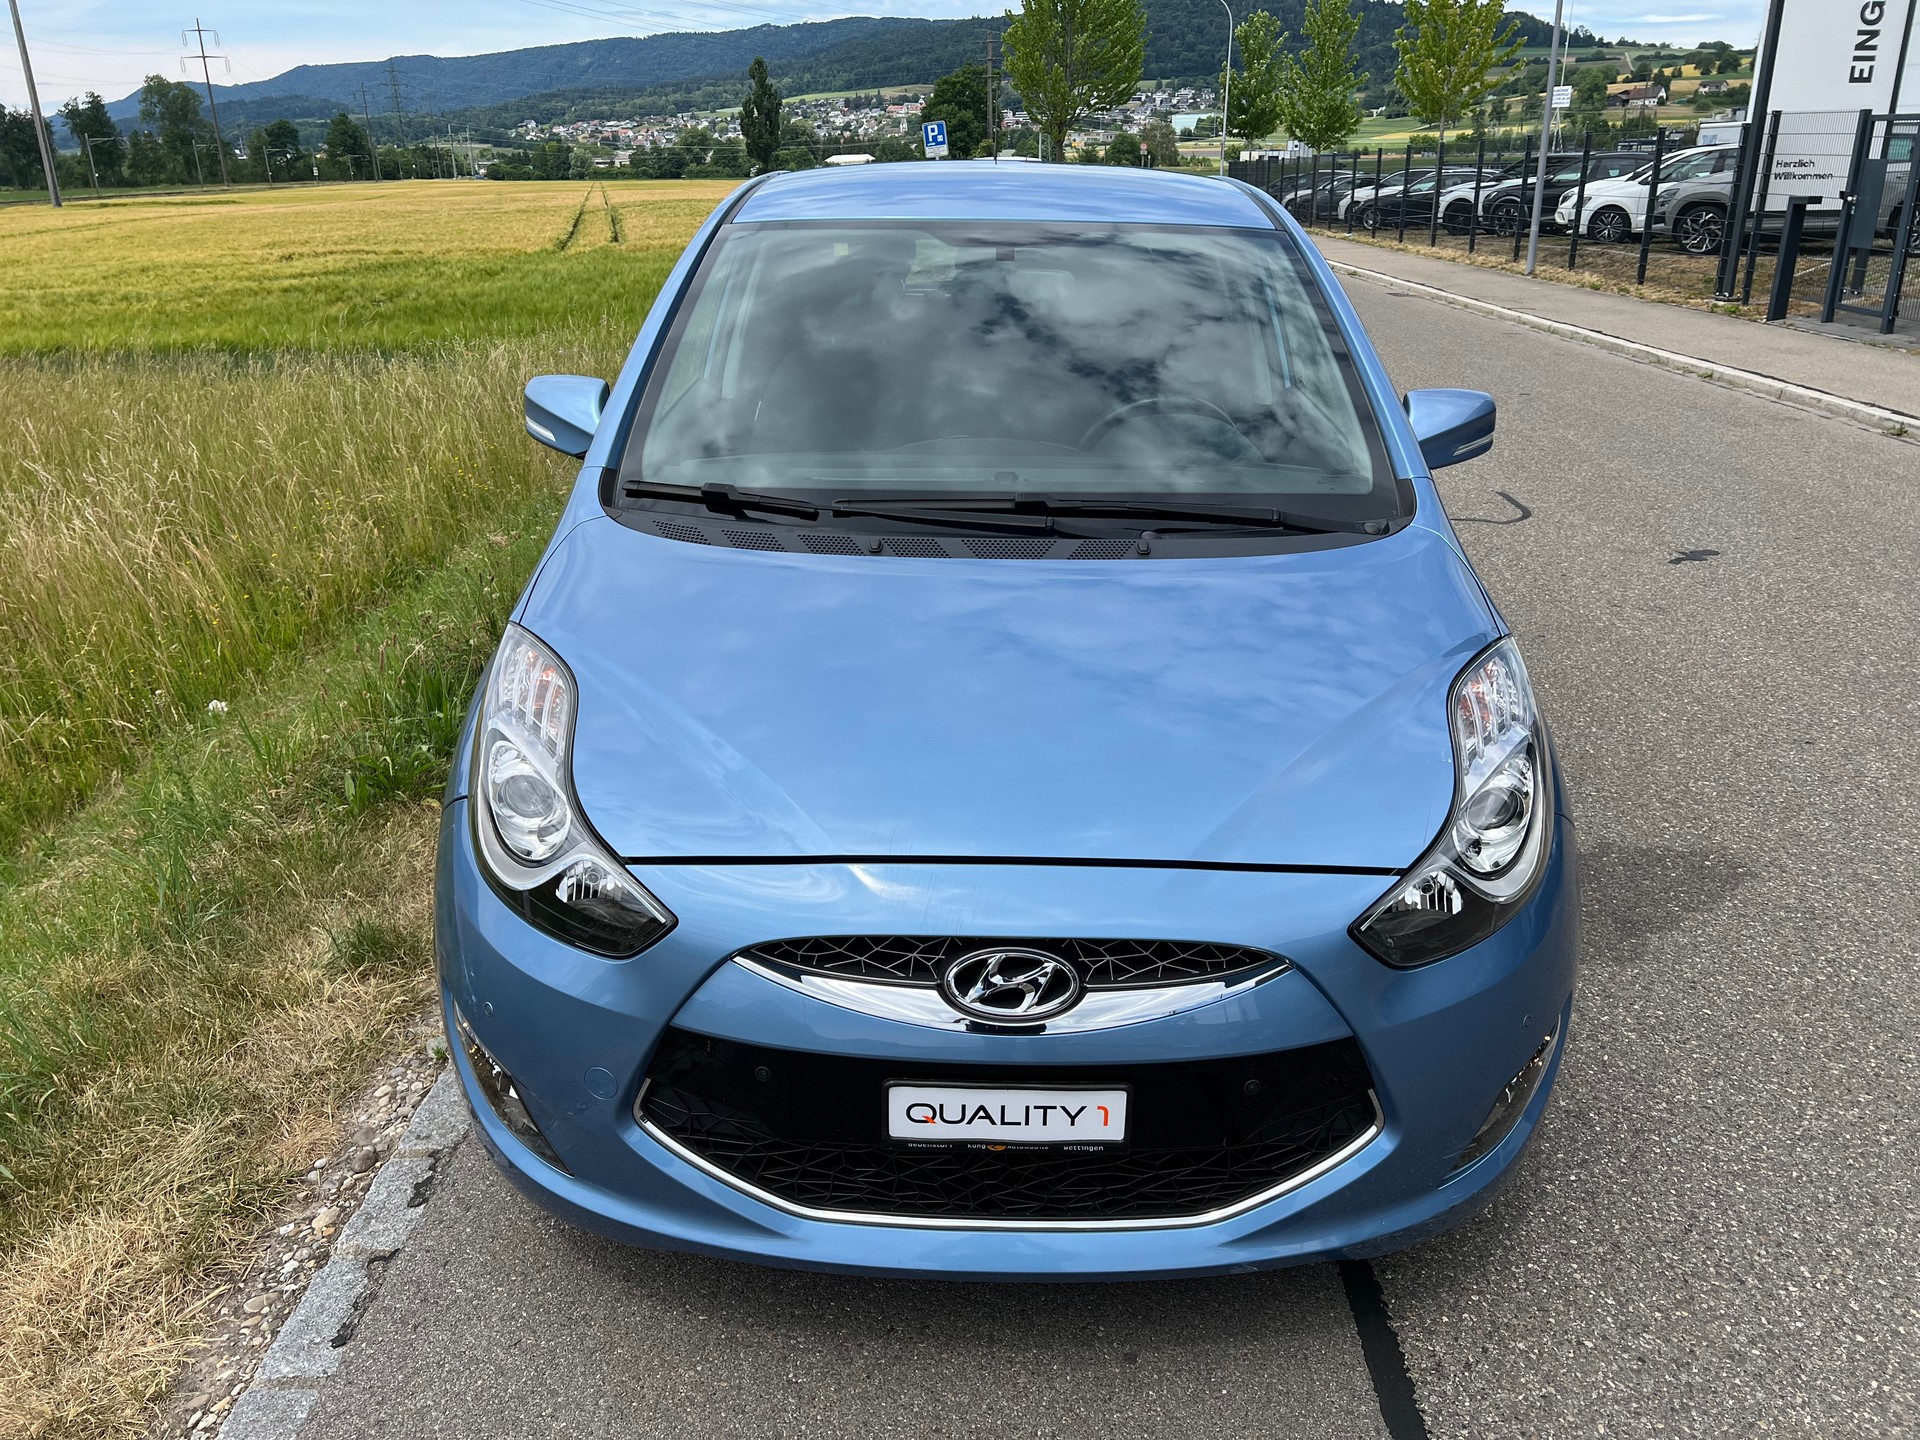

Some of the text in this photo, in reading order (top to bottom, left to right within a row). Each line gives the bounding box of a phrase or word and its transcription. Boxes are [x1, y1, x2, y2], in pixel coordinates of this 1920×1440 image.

[1848, 0, 1886, 84] EING
[927, 124, 938, 142] P
[1775, 159, 1815, 169] Herzlich
[1774, 172, 1834, 181] Willkommen
[905, 1102, 1088, 1127] QUALITY
